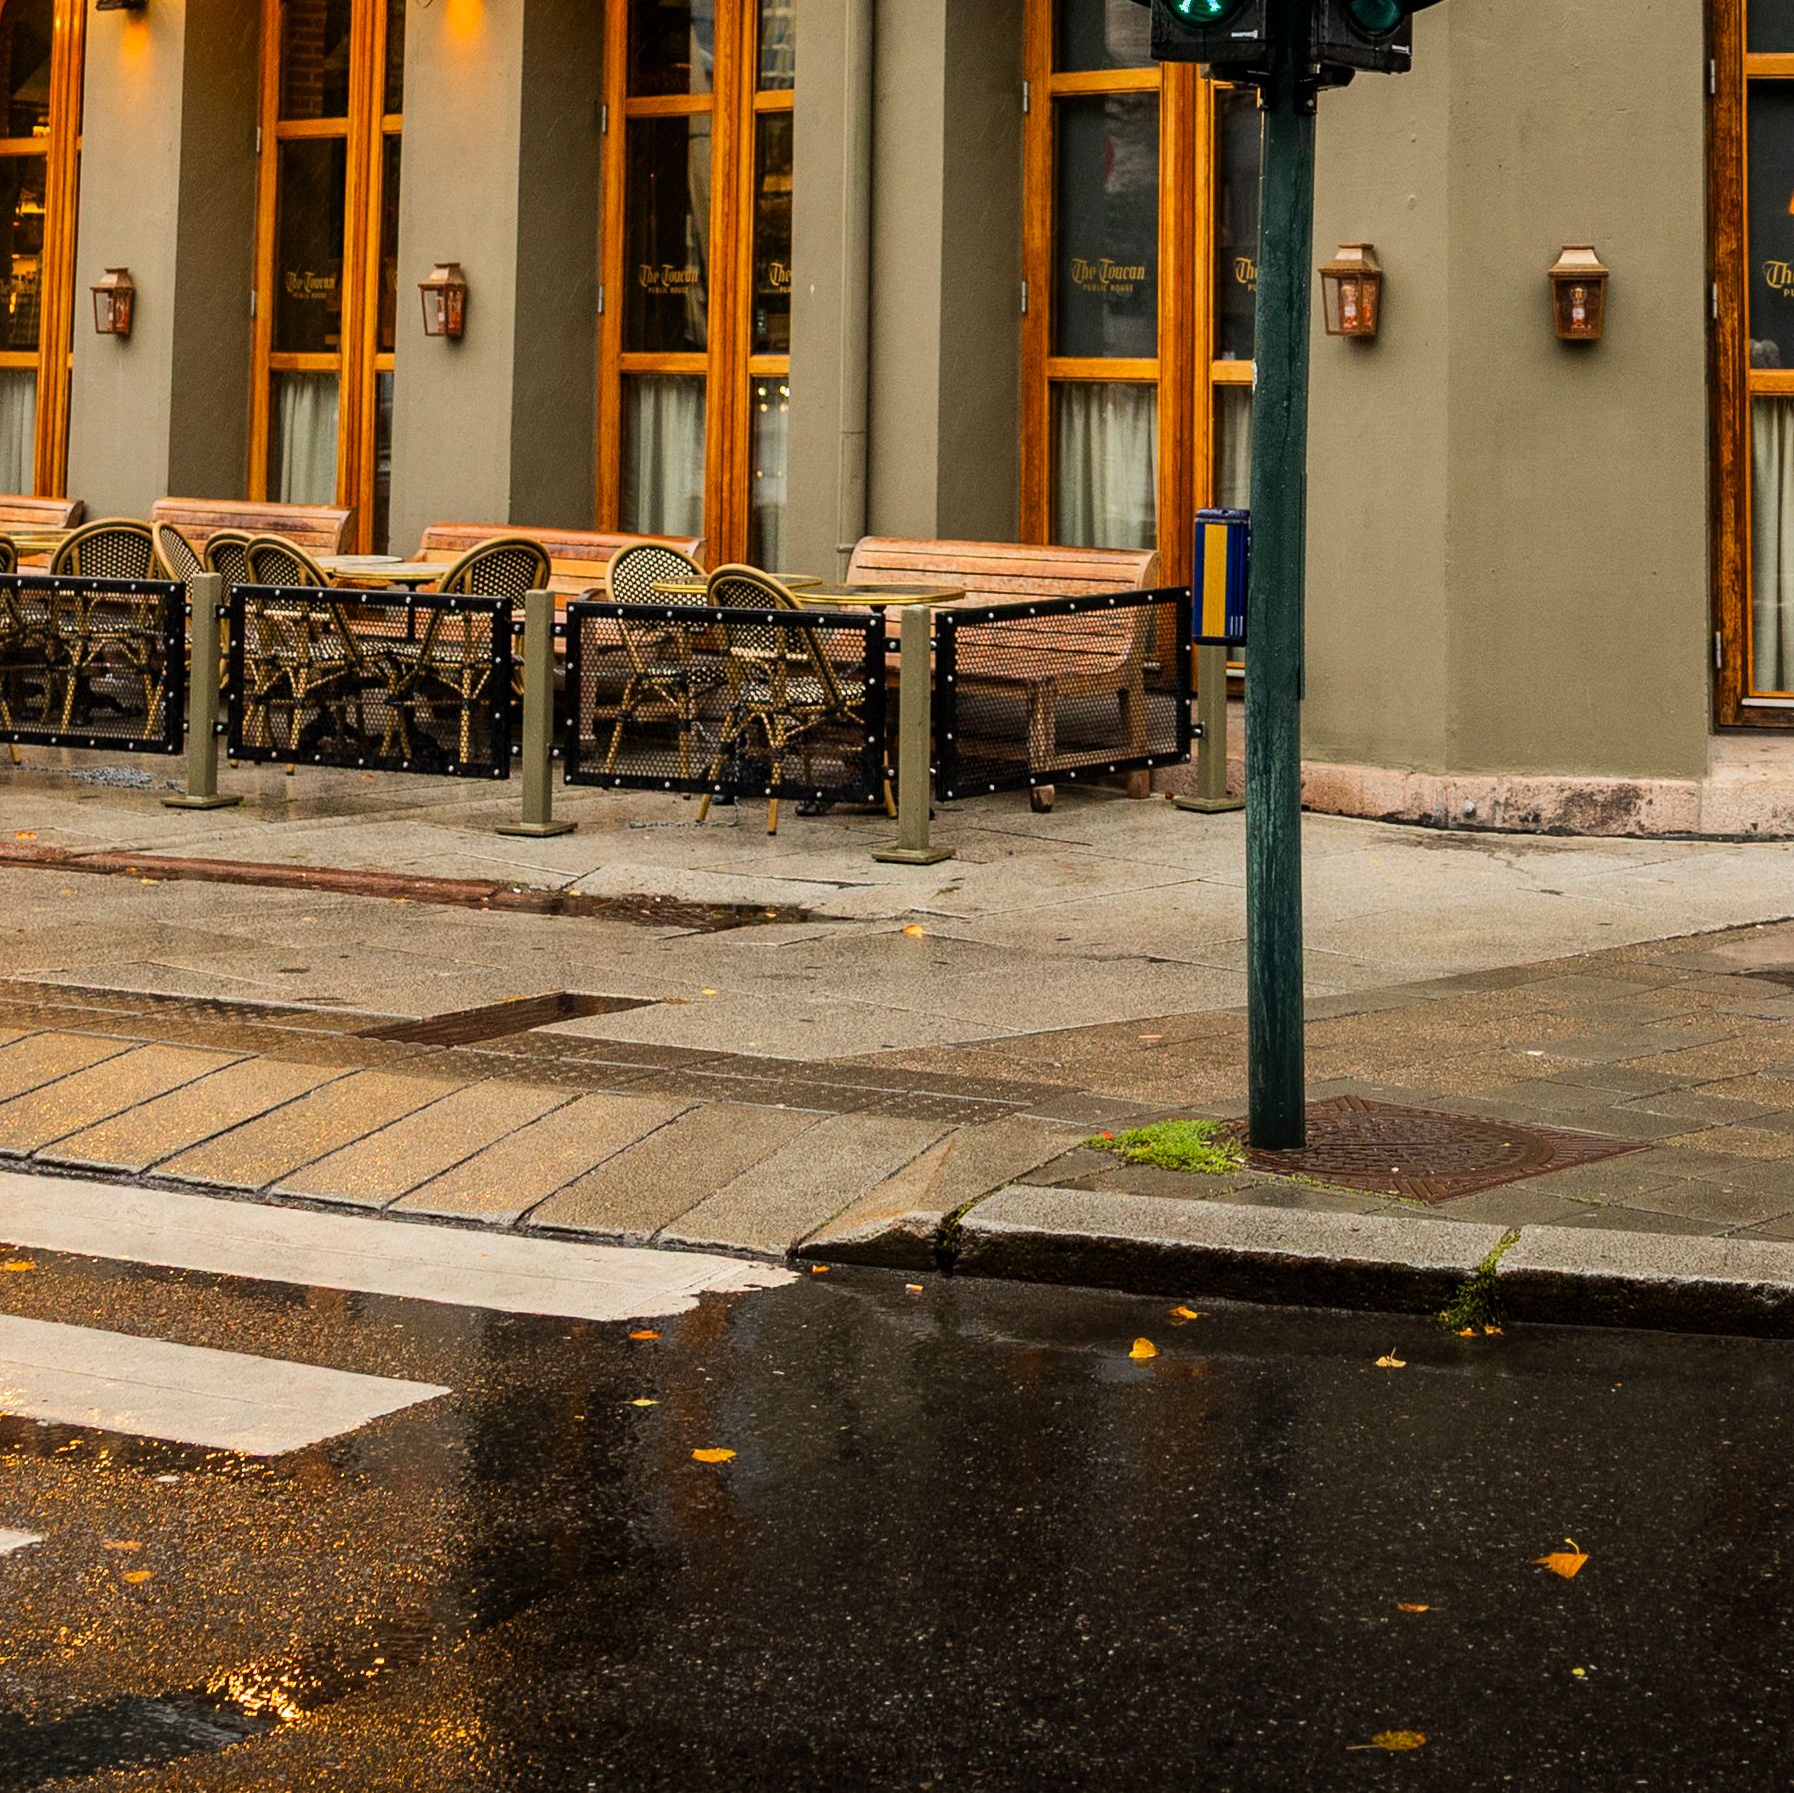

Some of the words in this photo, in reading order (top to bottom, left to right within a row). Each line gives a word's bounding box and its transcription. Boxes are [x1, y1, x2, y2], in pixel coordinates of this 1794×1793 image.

[639, 264, 659, 287] The
[661, 264, 699, 287] Toucan
[1071, 258, 1096, 284] The
[1098, 258, 1146, 284] Toucan
